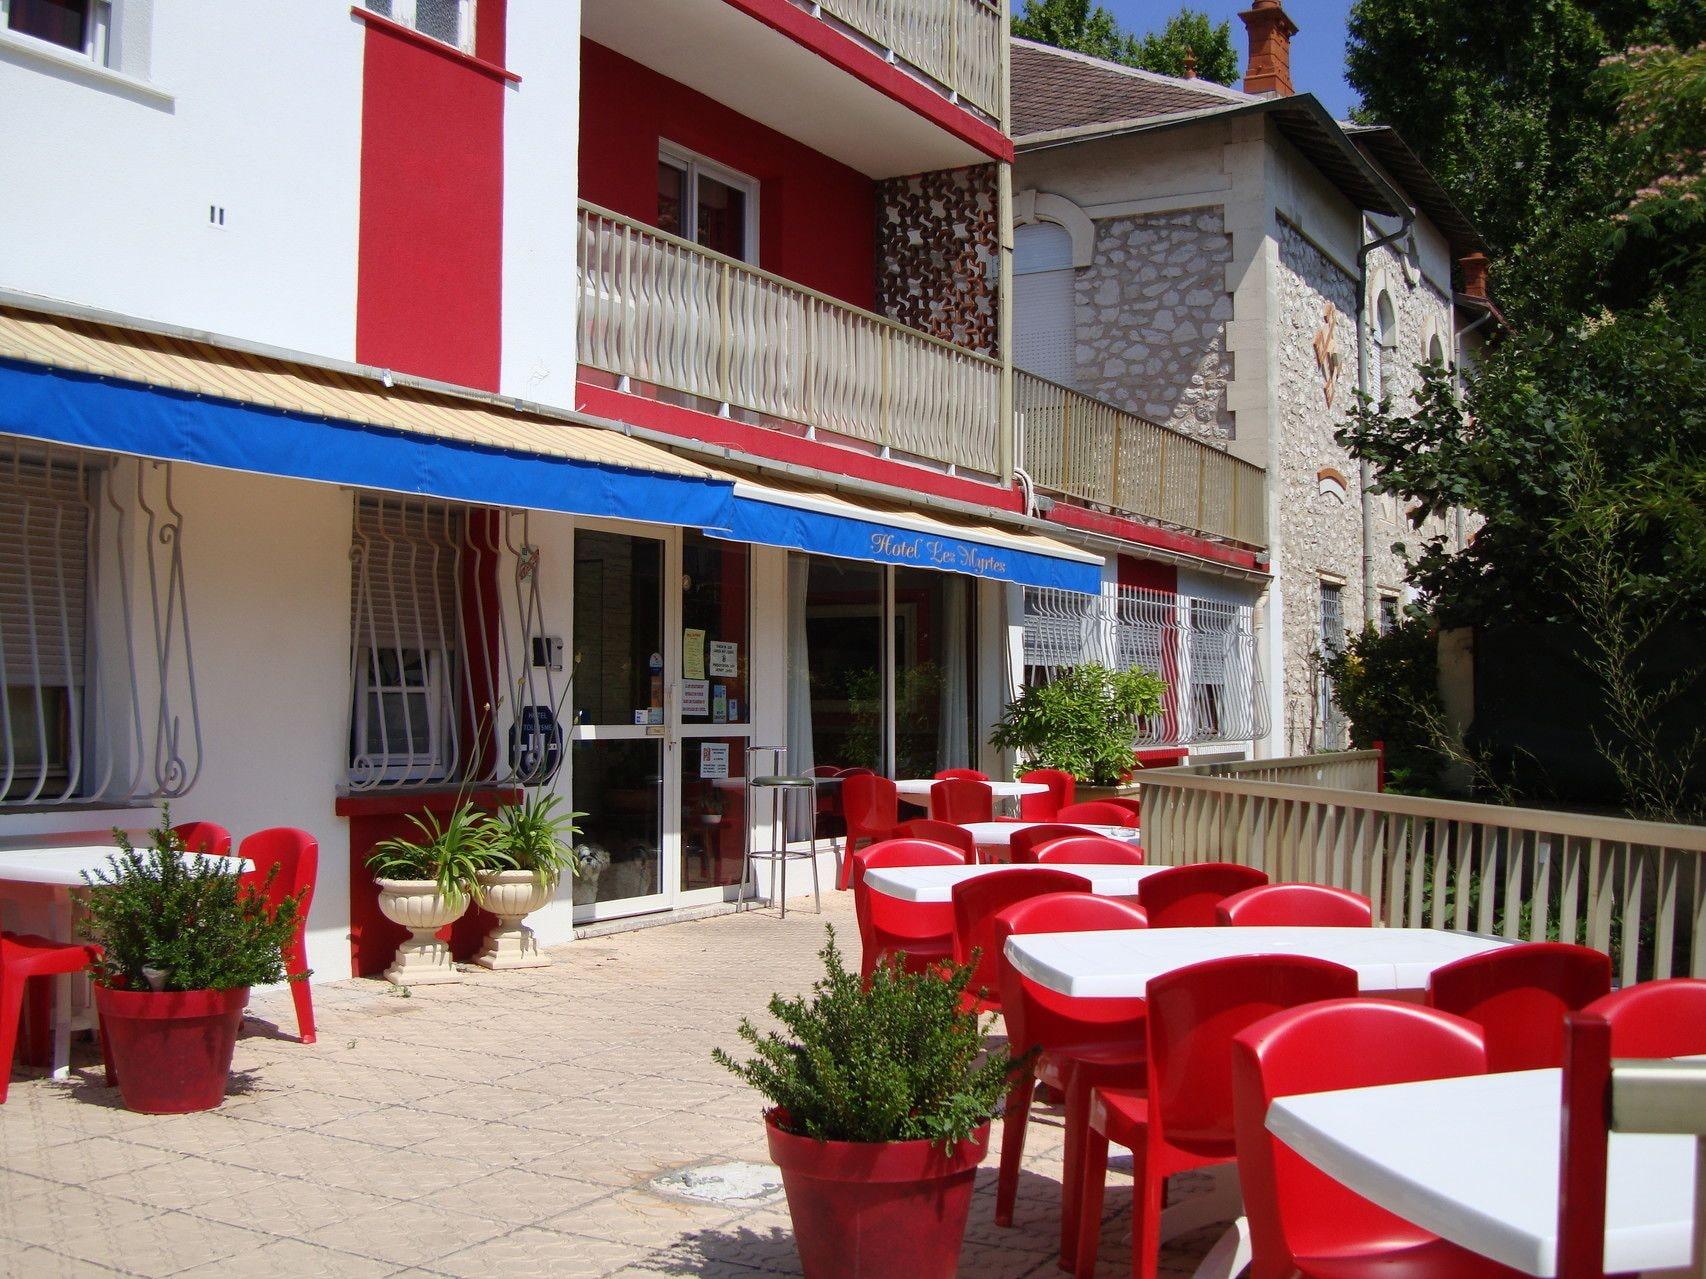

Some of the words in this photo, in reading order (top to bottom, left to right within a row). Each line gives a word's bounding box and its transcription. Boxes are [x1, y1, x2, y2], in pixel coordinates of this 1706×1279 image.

[871, 533, 922, 559] Hotel
[926, 541, 956, 563] Les
[957, 544, 1006, 573] Myrtes
[528, 711, 548, 719] HTEL
